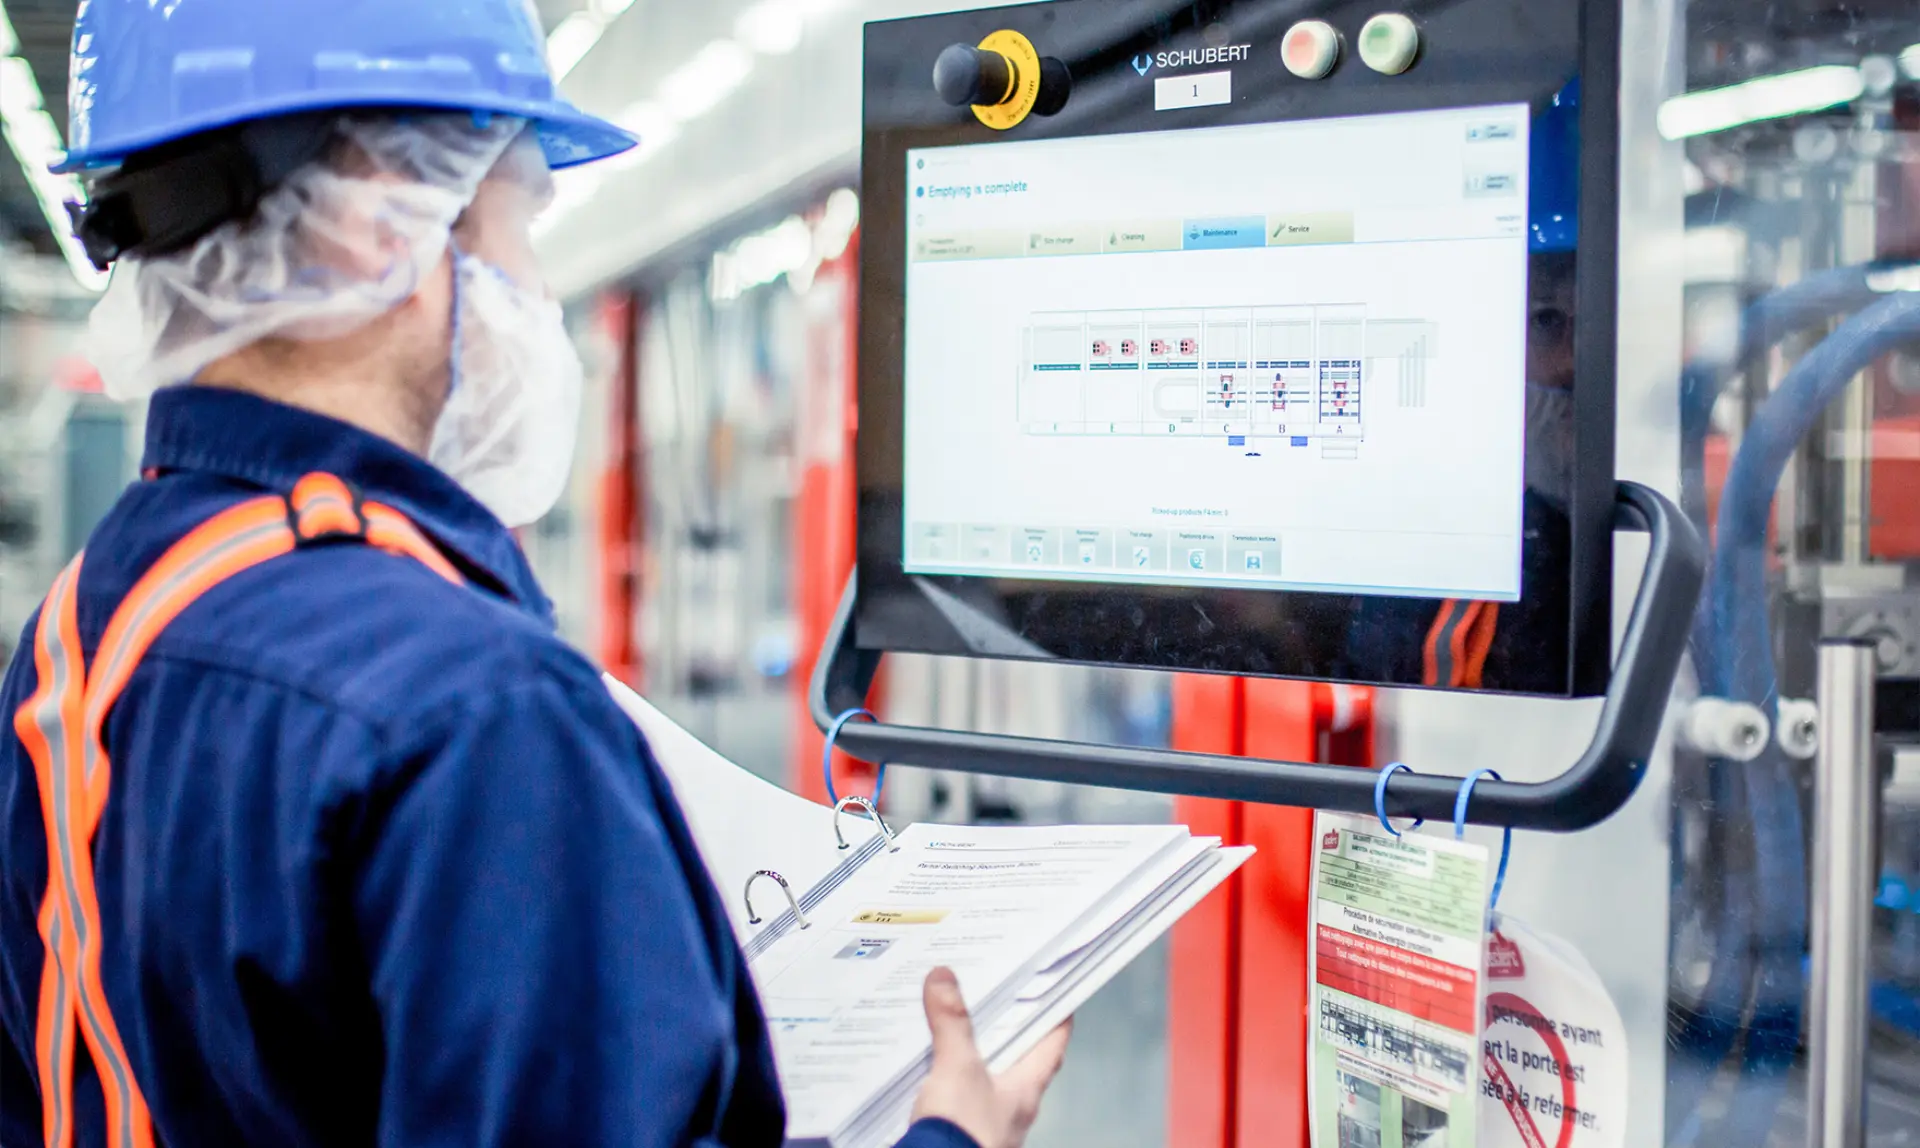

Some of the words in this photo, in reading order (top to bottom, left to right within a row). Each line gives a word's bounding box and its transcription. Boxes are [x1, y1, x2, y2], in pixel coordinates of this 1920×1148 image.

[1156, 44, 1251, 68] SCHUBERT
[1192, 84, 1198, 97] 1
[929, 184, 971, 199] Emptying
[974, 183, 982, 194] is
[985, 180, 1027, 196] complete
[1203, 228, 1238, 238] Maintenance
[1288, 224, 1310, 233] Service
[1223, 424, 1230, 433] C
[1279, 424, 1286, 433] B
[1337, 425, 1343, 434] A
[1492, 1004, 1556, 1034] personne
[1561, 1021, 1603, 1047] ayant
[1506, 1039, 1518, 1064] la
[1522, 1050, 1560, 1076] porte
[1563, 1063, 1585, 1084] est
[1519, 1083, 1530, 1109] la
[1534, 1093, 1600, 1132] refermer.
